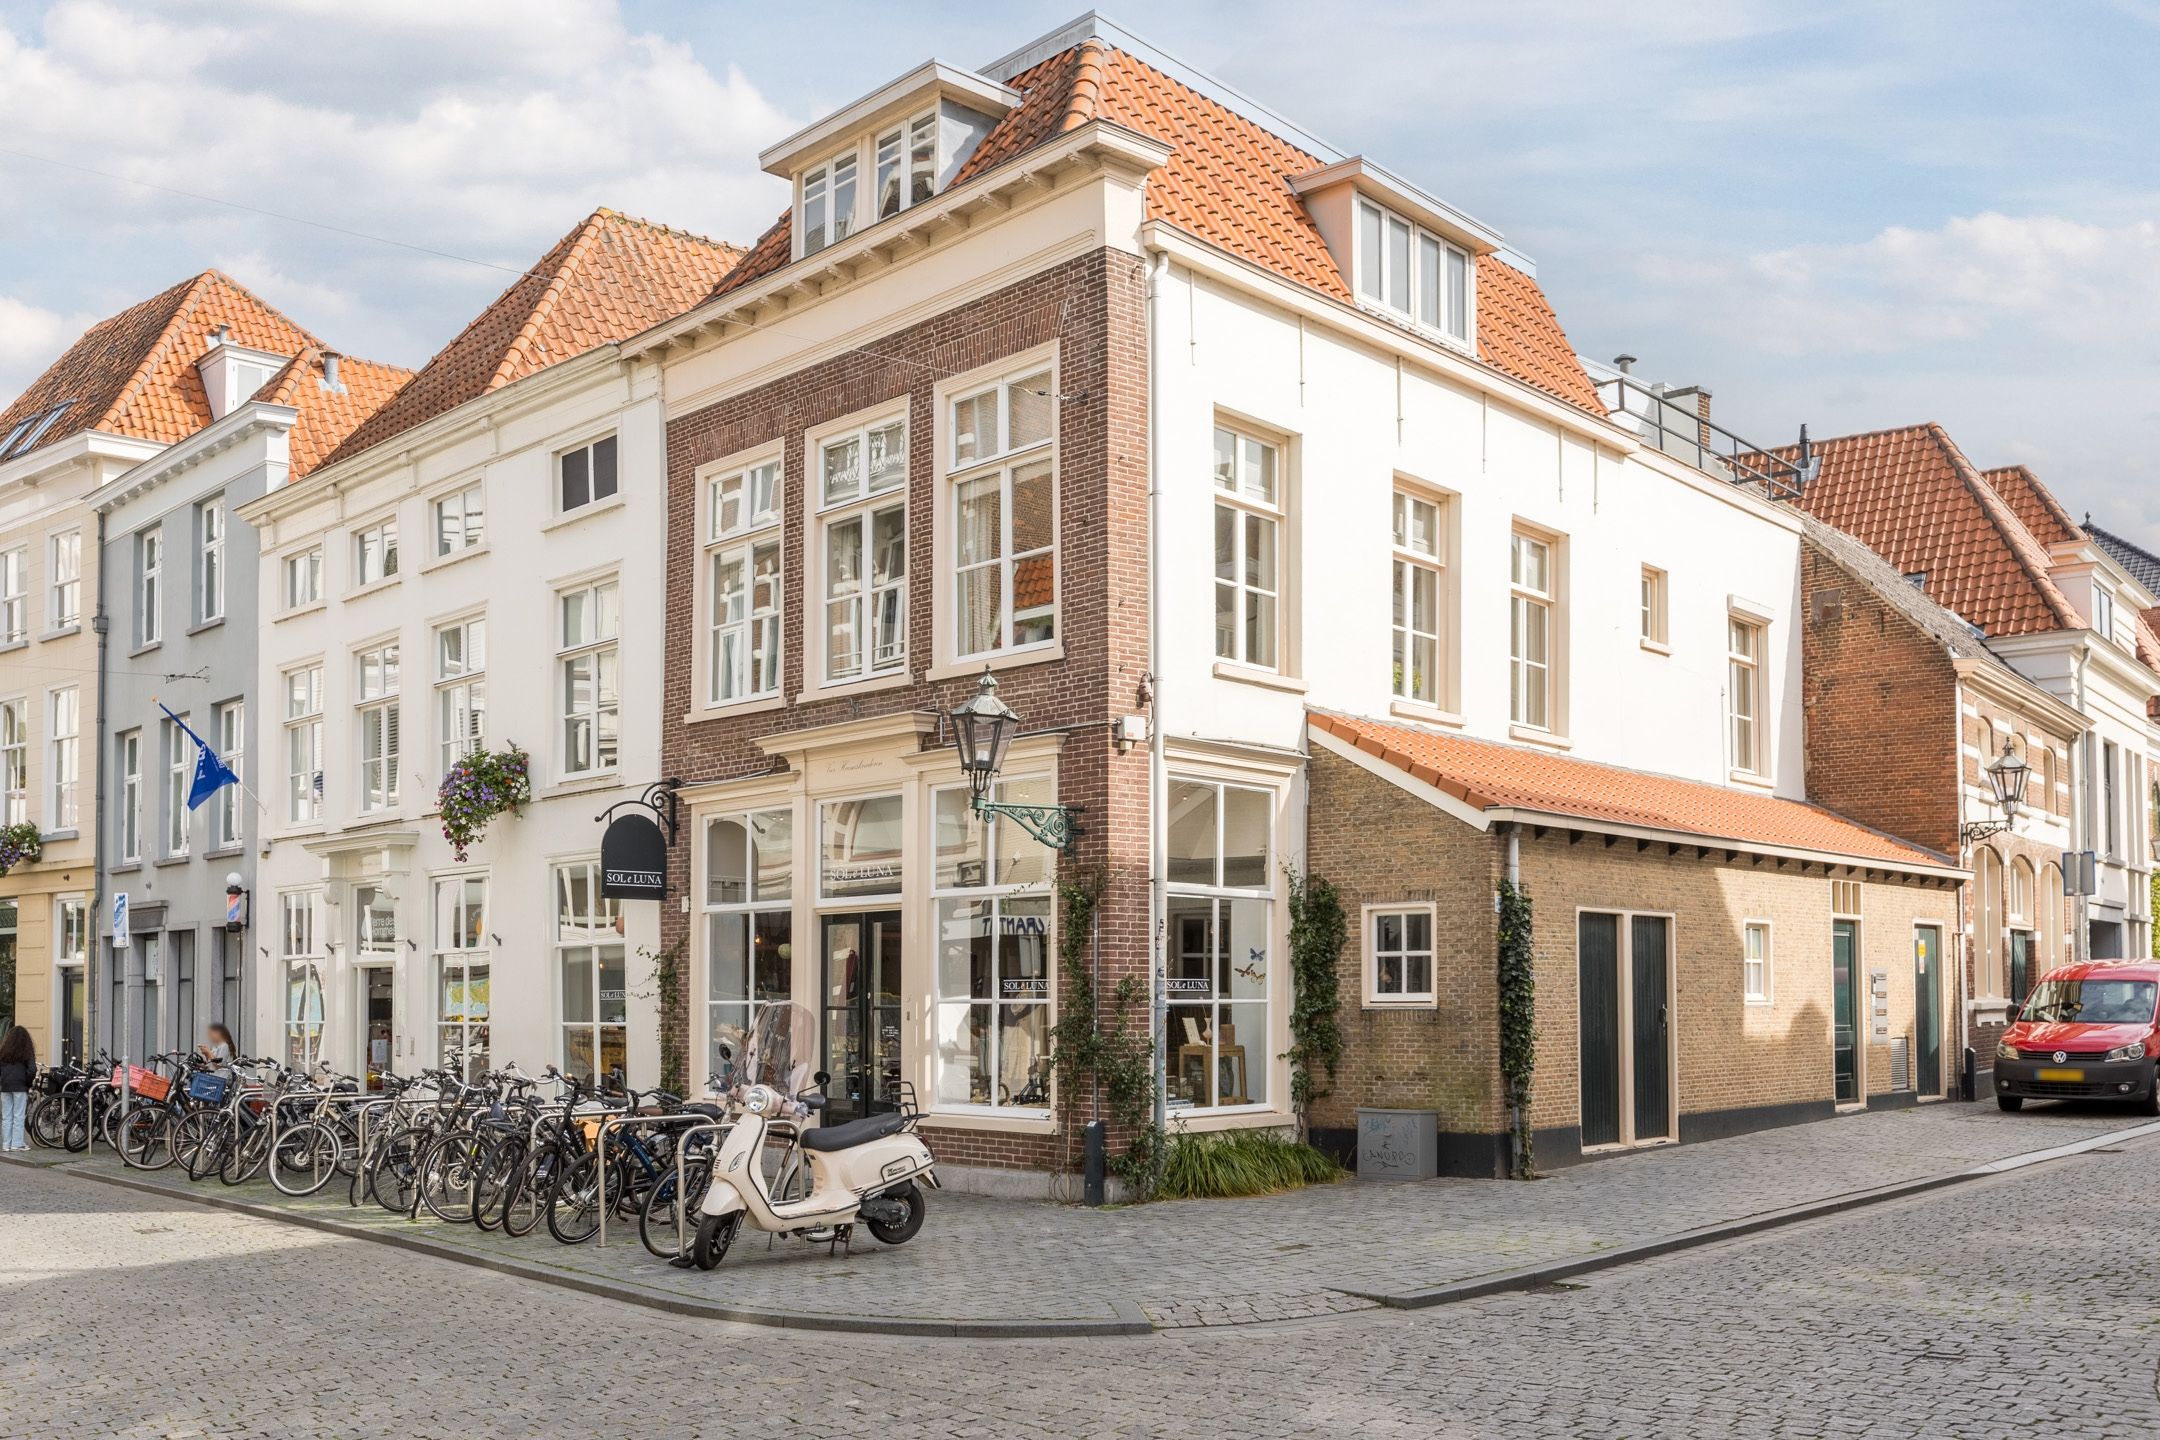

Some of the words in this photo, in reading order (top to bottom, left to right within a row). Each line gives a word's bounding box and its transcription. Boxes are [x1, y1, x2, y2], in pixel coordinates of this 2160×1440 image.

[830, 868, 852, 880] SOL
[860, 865, 893, 878] LUNA
[606, 873, 626, 883] SOL
[627, 875, 632, 883] e
[633, 874, 662, 884] LUNA
[1004, 982, 1020, 990] SOL
[1167, 981, 1182, 989] SOL
[1187, 981, 1209, 989] LUNA
[614, 991, 626, 999] LUN
